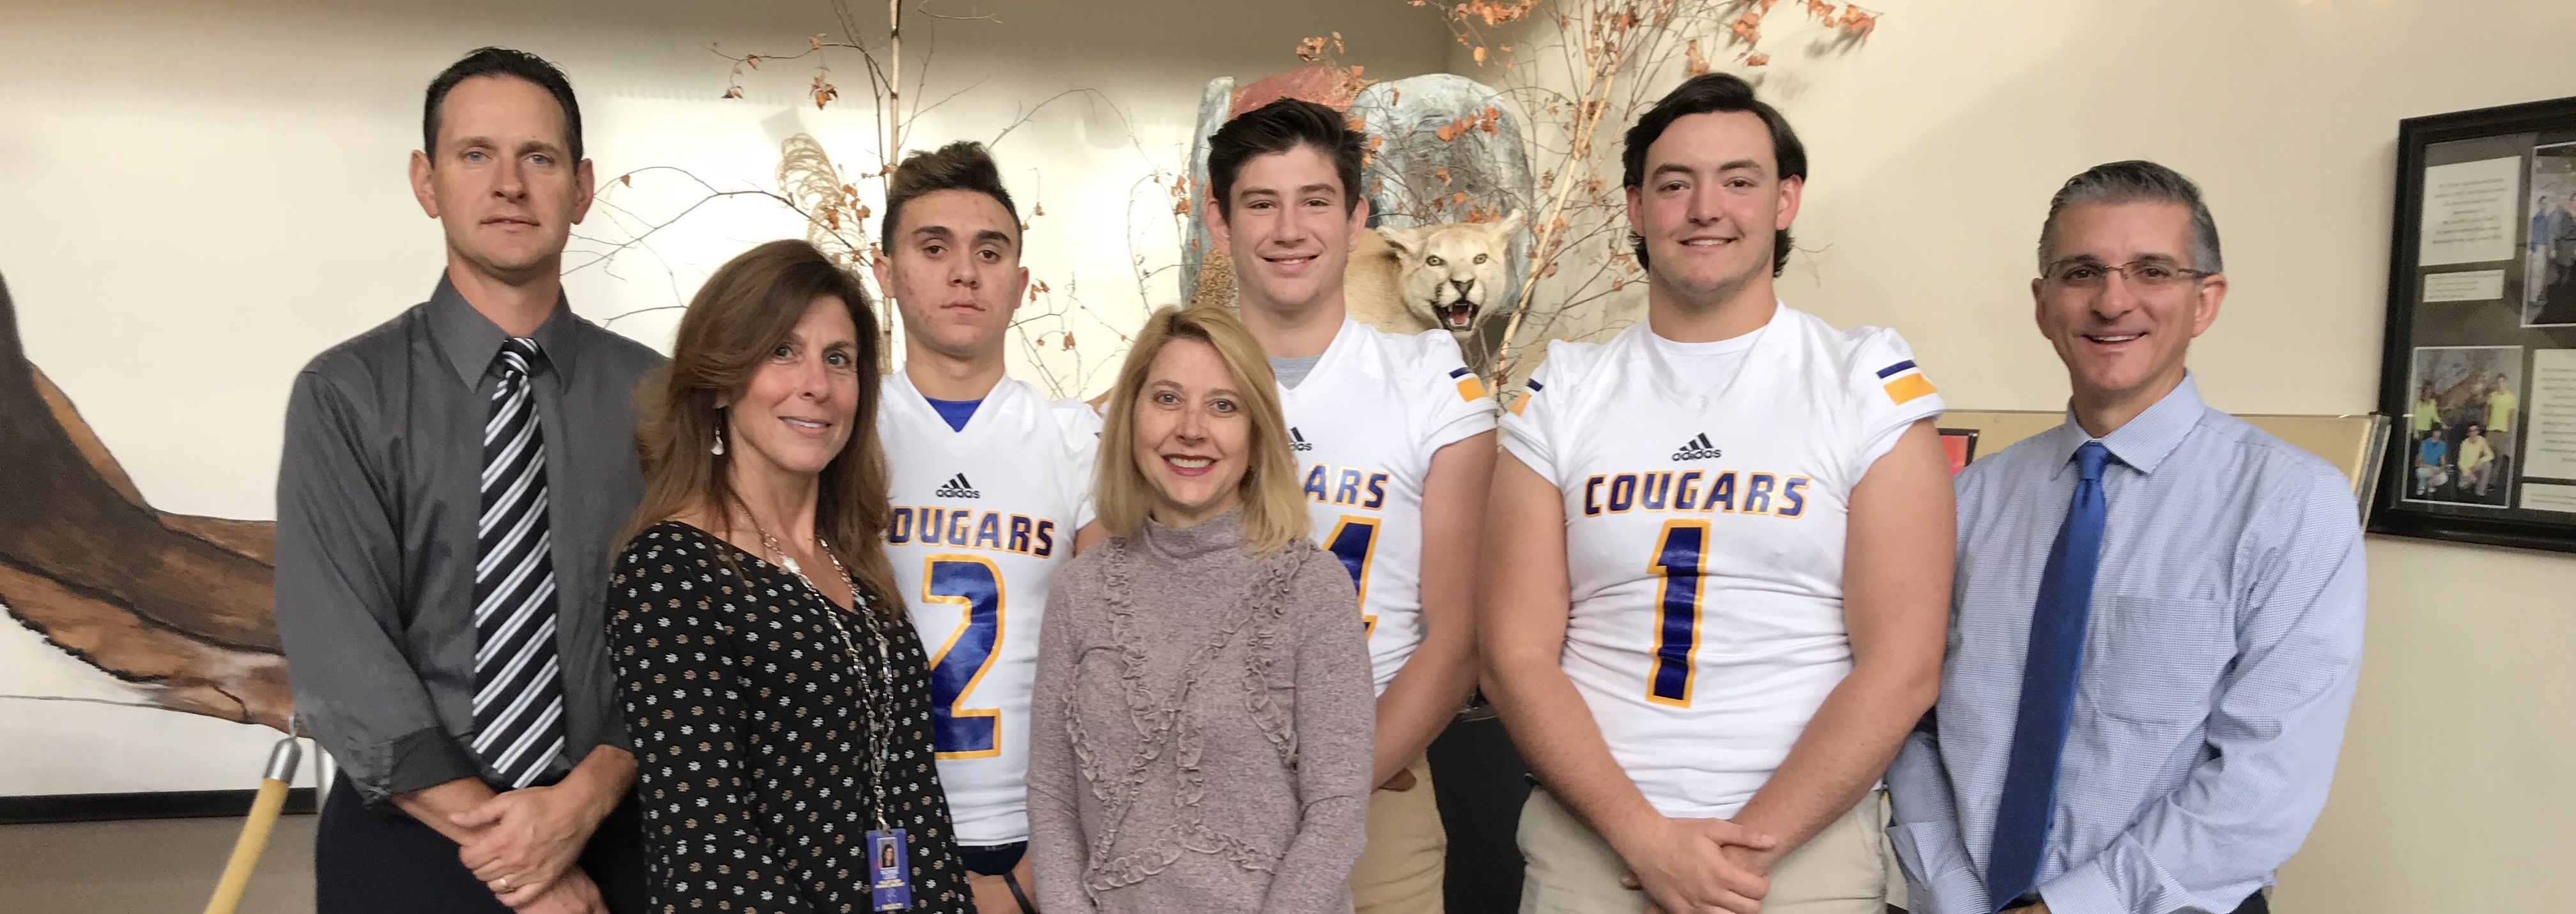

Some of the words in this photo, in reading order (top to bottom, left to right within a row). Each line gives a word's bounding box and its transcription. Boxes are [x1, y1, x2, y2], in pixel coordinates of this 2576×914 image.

[1672, 448, 1722, 461] adidas
[935, 488, 980, 499] adidas
[1302, 462, 1390, 511] ARS
[1584, 469, 1811, 519] COUGARS
[889, 506, 1055, 559] OUGARS
[1645, 519, 1712, 708] 1
[921, 554, 1005, 759] 2
